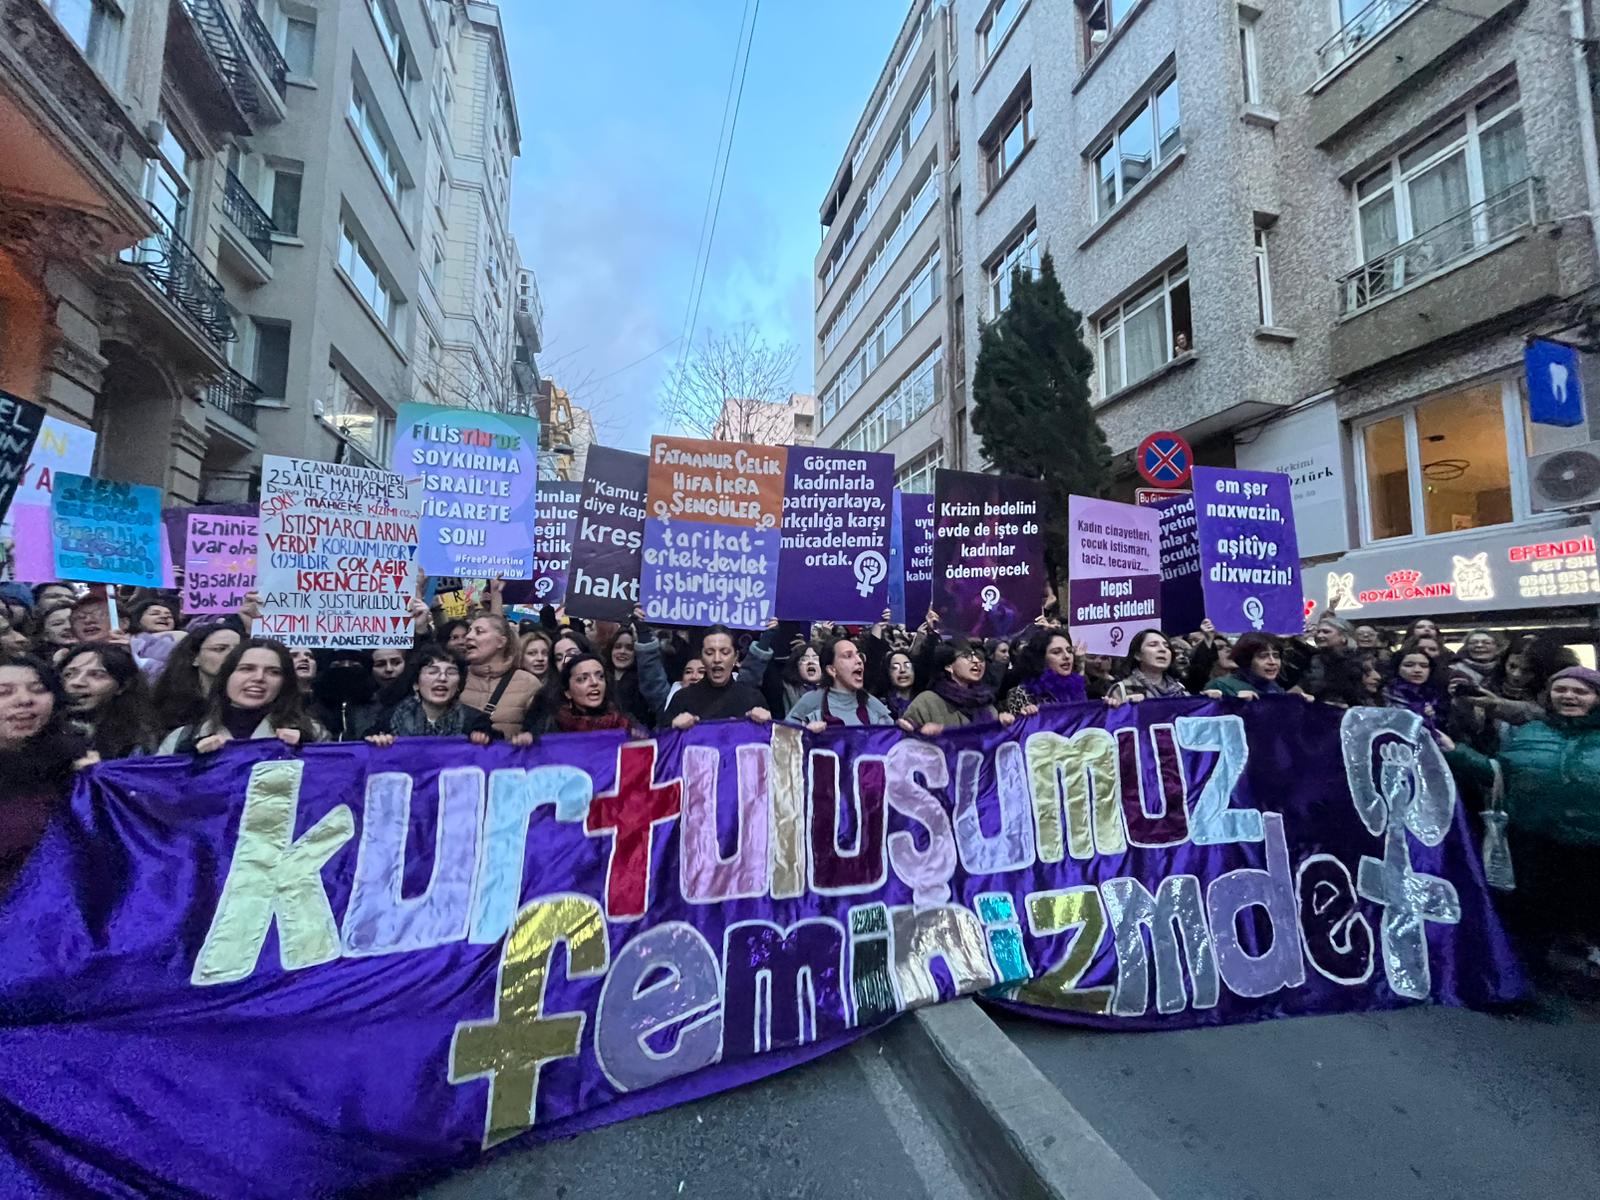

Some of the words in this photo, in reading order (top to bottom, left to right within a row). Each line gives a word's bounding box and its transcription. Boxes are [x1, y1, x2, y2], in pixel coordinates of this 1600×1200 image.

[411, 449, 520, 474] SOYKIRIMA
[803, 456, 867, 474] Göçmen
[793, 474, 875, 490] kadınlarla
[1216, 479, 1240, 494] em
[1243, 482, 1268, 500] şer
[583, 497, 615, 515] diye
[782, 492, 886, 512] patriyarkaya,
[941, 502, 980, 516] Krizin
[984, 501, 1036, 515] bedelini
[847, 512, 885, 531] karşı
[1207, 503, 1285, 525] naxwazin,
[438, 527, 486, 547] SON!
[580, 517, 642, 554] kreş
[938, 522, 970, 537] evde
[974, 522, 990, 536] de
[994, 521, 1019, 539] işte
[1022, 520, 1039, 534] de
[1077, 520, 1103, 535] Kadın
[192, 540, 227, 555] var
[533, 539, 571, 552] itlik
[780, 531, 884, 549] mücadelemiz
[961, 542, 1016, 557] kadınlar
[1218, 534, 1278, 560] aşitîye
[644, 548, 767, 574] erkek-devlet
[805, 550, 853, 566] ortak.
[945, 561, 1030, 580] ödemeyecek
[1210, 561, 1292, 586] dixwazin!
[189, 572, 258, 590] yasaklar
[655, 569, 767, 602] işbirliğiyle
[1100, 579, 1133, 598] Hepsi
[189, 591, 218, 609] yok
[1360, 587, 1402, 603] ROYAL
[1402, 582, 1453, 600] CANIN
[646, 595, 770, 626] öldürüldü!
[1077, 602, 1111, 621] erkek
[1113, 598, 1155, 620] şiddeti!
[190, 715, 1264, 986] kurtuluşumuz
[447, 812, 1375, 1150] feminizmde
